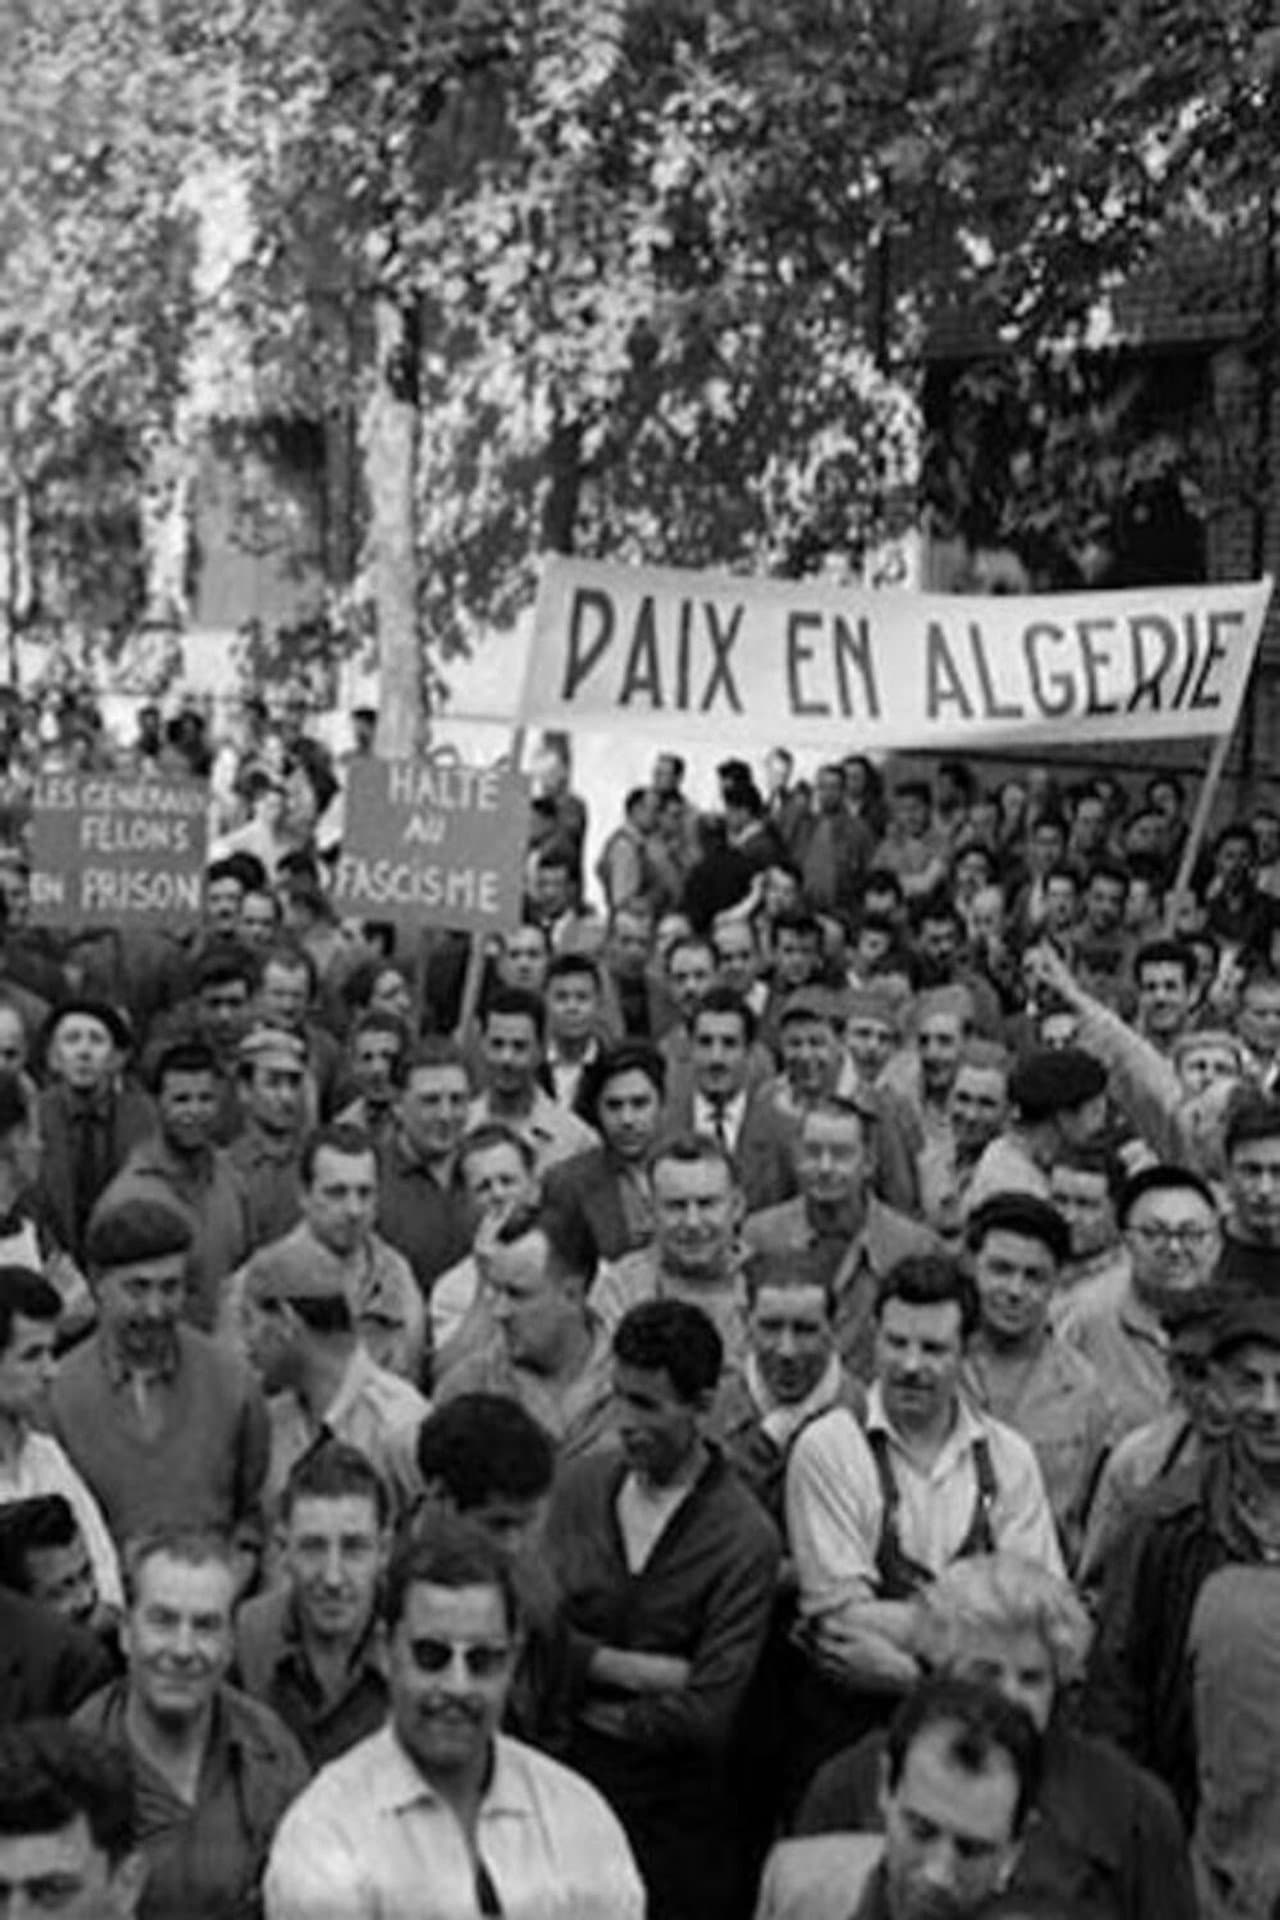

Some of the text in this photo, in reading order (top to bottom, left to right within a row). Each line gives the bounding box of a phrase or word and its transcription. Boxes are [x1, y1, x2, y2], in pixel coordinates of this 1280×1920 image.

[563, 588, 1246, 718] PAIX EN ALGERIE
[34, 778, 77, 809] LES
[389, 767, 498, 810] HALTE
[404, 814, 446, 842] AU
[82, 870, 199, 910] PRISON
